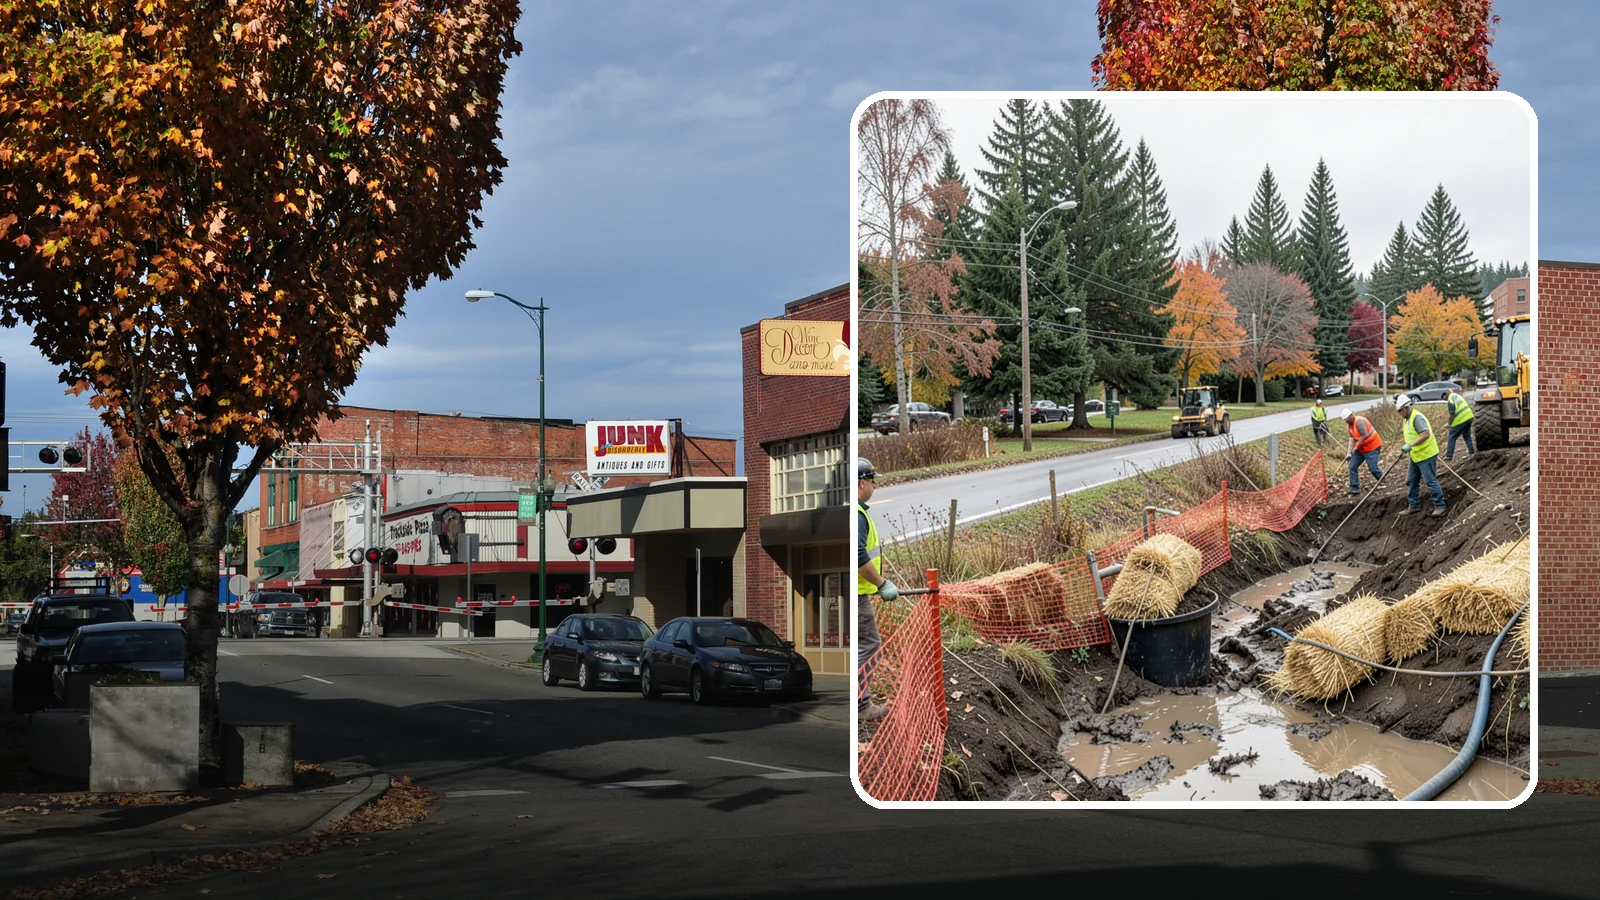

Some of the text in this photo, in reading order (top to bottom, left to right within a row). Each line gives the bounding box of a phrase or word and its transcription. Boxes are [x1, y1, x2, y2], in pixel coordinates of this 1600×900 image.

[595, 425, 665, 457] JUNK
[607, 446, 646, 454] DISORDERLY
[596, 460, 665, 470] ANTIQUES AND GIFTS
[414, 519, 429, 535] Pizza
